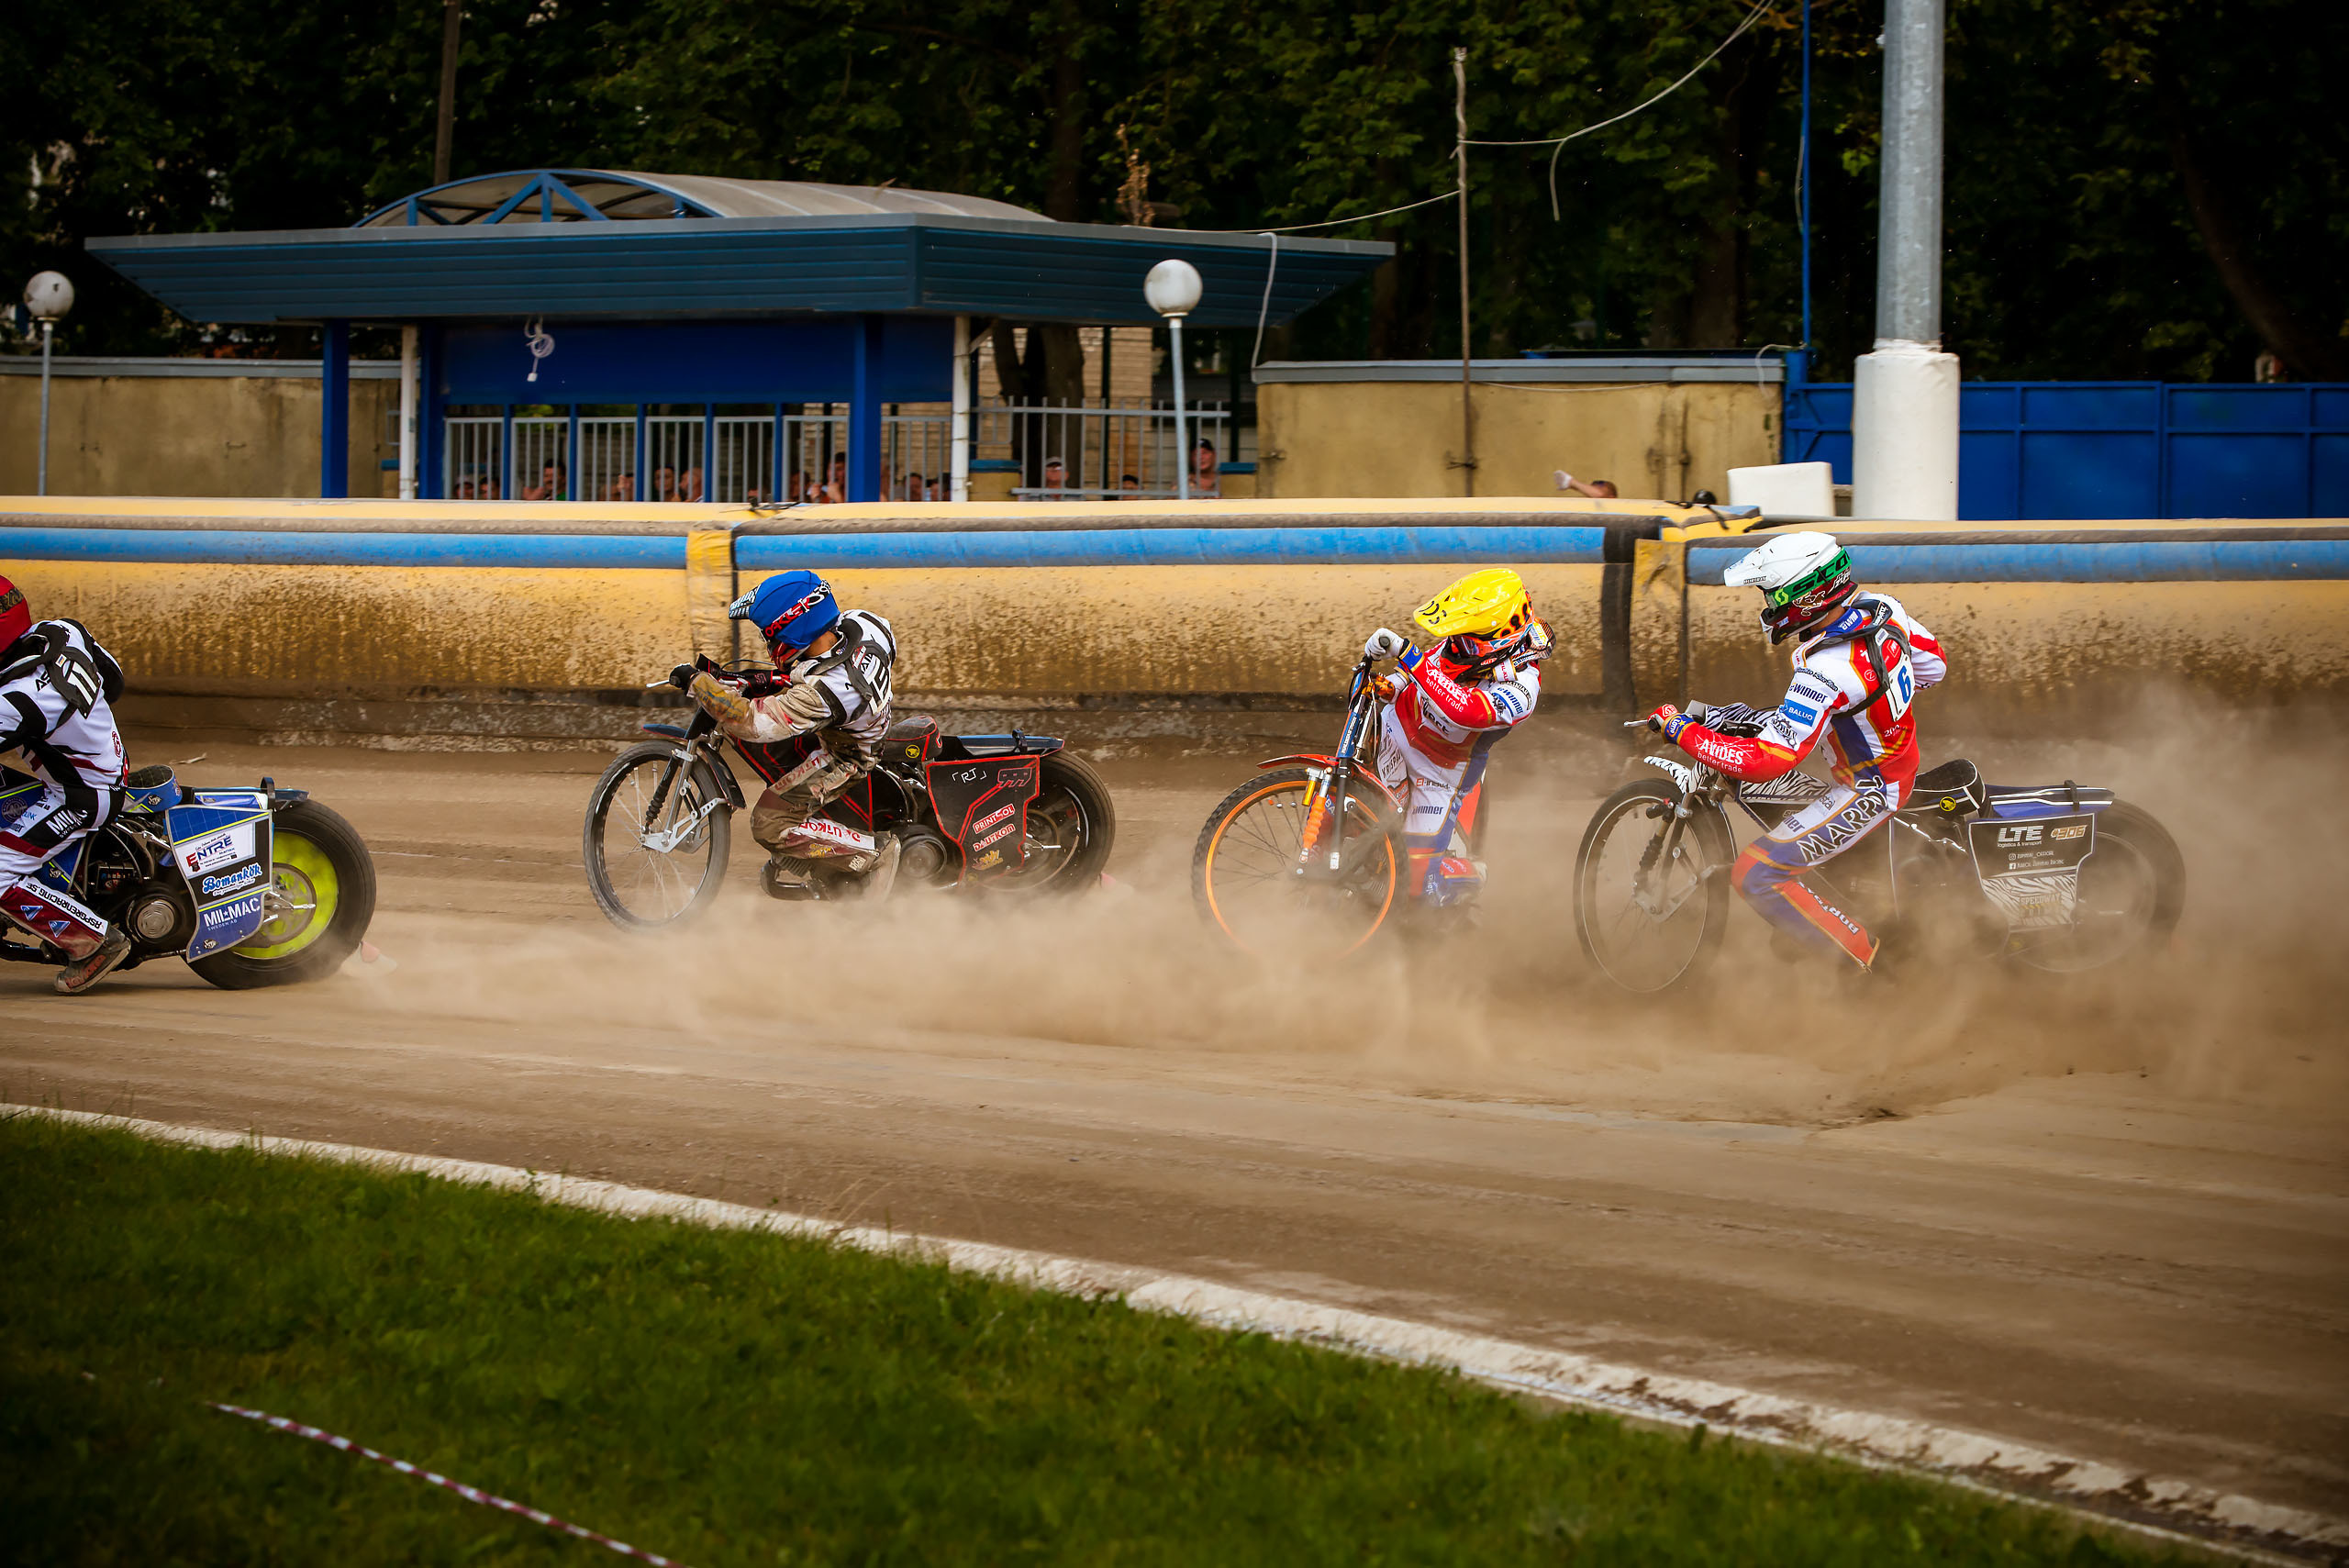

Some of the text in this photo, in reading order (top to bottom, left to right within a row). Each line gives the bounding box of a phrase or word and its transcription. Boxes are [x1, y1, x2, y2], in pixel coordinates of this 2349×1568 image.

[1788, 550, 1851, 600] SCO
[1426, 677, 1464, 713] better trade
[1898, 665, 1911, 704] 6
[1698, 750, 1742, 773] better trade
[1699, 739, 1744, 765] AVIDES
[1998, 825, 2043, 842] LTE
